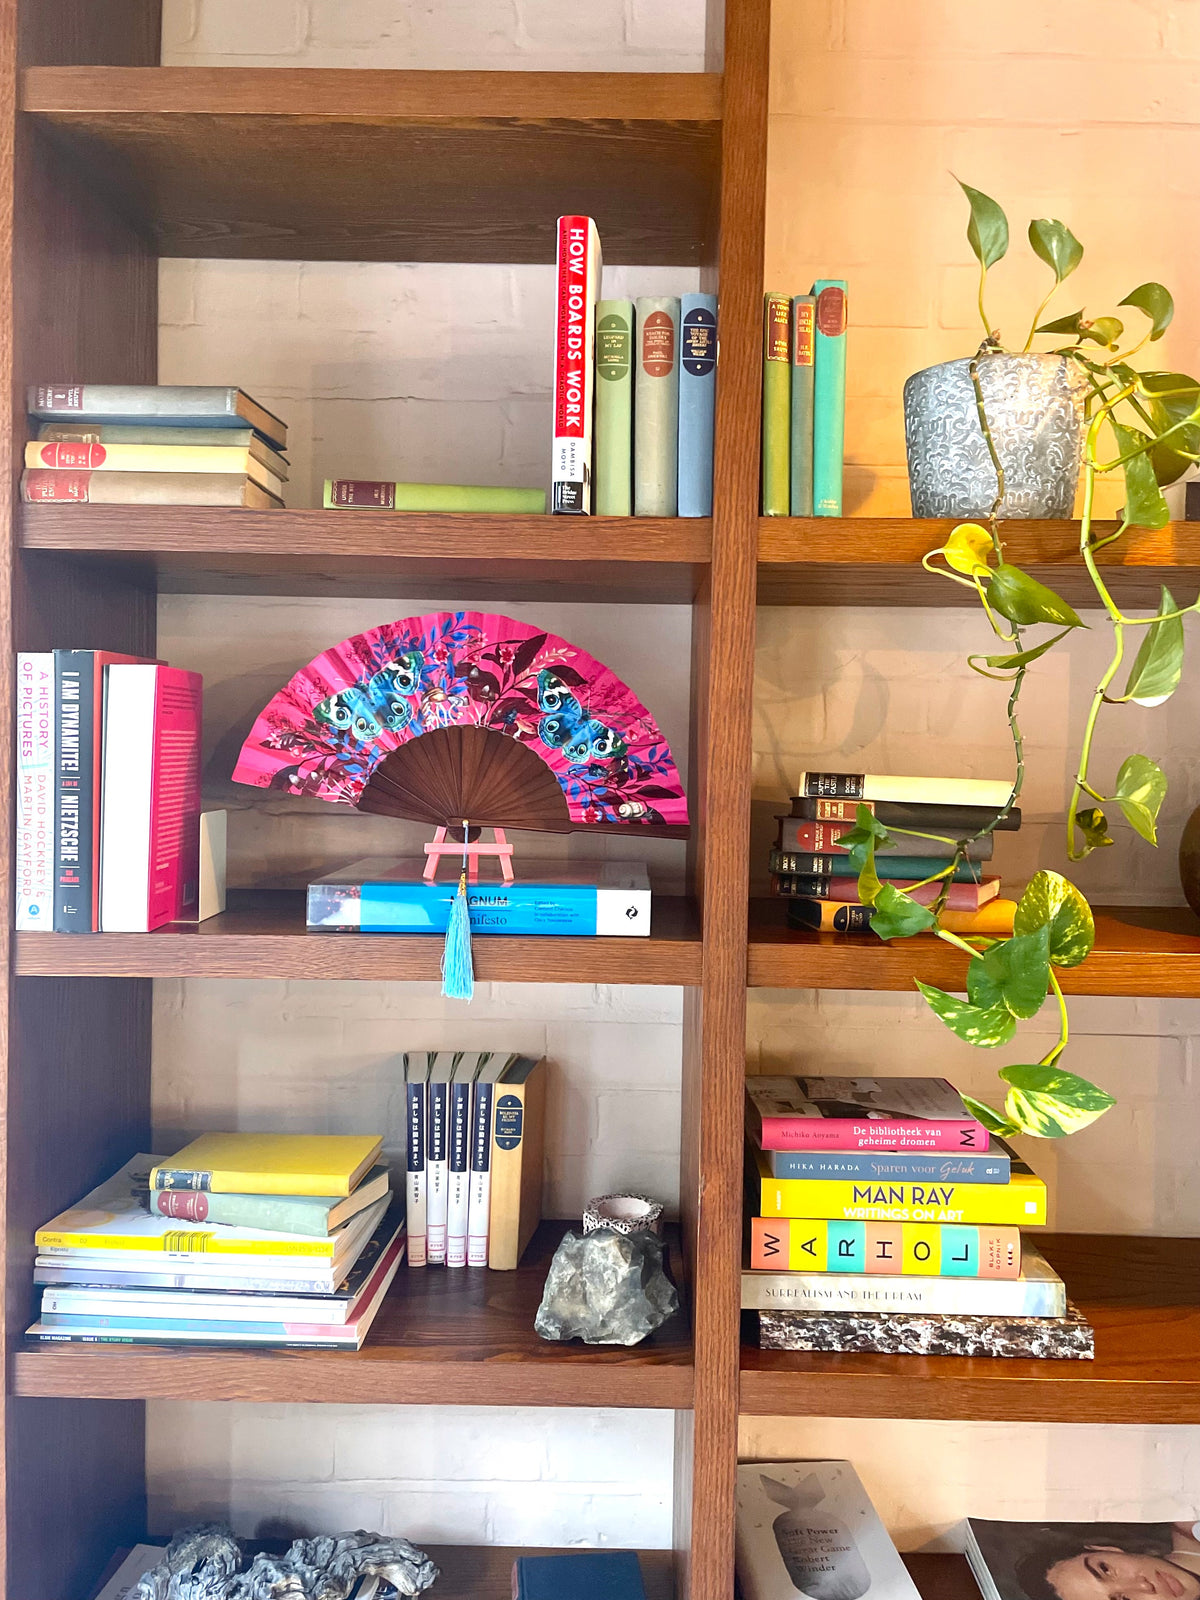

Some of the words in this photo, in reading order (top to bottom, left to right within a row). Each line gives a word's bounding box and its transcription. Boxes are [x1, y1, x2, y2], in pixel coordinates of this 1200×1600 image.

[569, 228, 584, 275] HOW
[568, 285, 583, 360] BOARDS
[566, 370, 582, 428] WORK
[23, 662, 32, 681] OF
[40, 671, 48, 680] A
[61, 680, 80, 700] AM
[22, 688, 32, 757] PICTURES
[39, 686, 48, 748] HISTORY
[61, 704, 80, 772] DYNAMITE!
[23, 775, 32, 826] MARTIN
[37, 774, 46, 815] DAVID
[60, 795, 79, 862] NIETZSCHE
[23, 832, 32, 896] GAYFORD
[37, 821, 46, 886] HOCKNEY
[470, 914, 508, 925] nifesto
[853, 1126, 866, 1135] De
[870, 1126, 922, 1136] bibliotheek
[858, 1138, 896, 1146] geheime
[900, 1138, 936, 1146] dromen
[871, 1162, 908, 1174] Sparen
[938, 1161, 975, 1180] Geluk
[843, 1207, 910, 1220] WRITINGS
[913, 1209, 933, 1220] ON
[937, 1210, 964, 1222] ART
[853, 1185, 904, 1204] MAN
[912, 1187, 955, 1206] RAY
[765, 1289, 832, 1298] SURREALISM
[838, 1290, 858, 1299] AND
[862, 1291, 880, 1299] THE
[884, 1292, 922, 1301] DREAM
